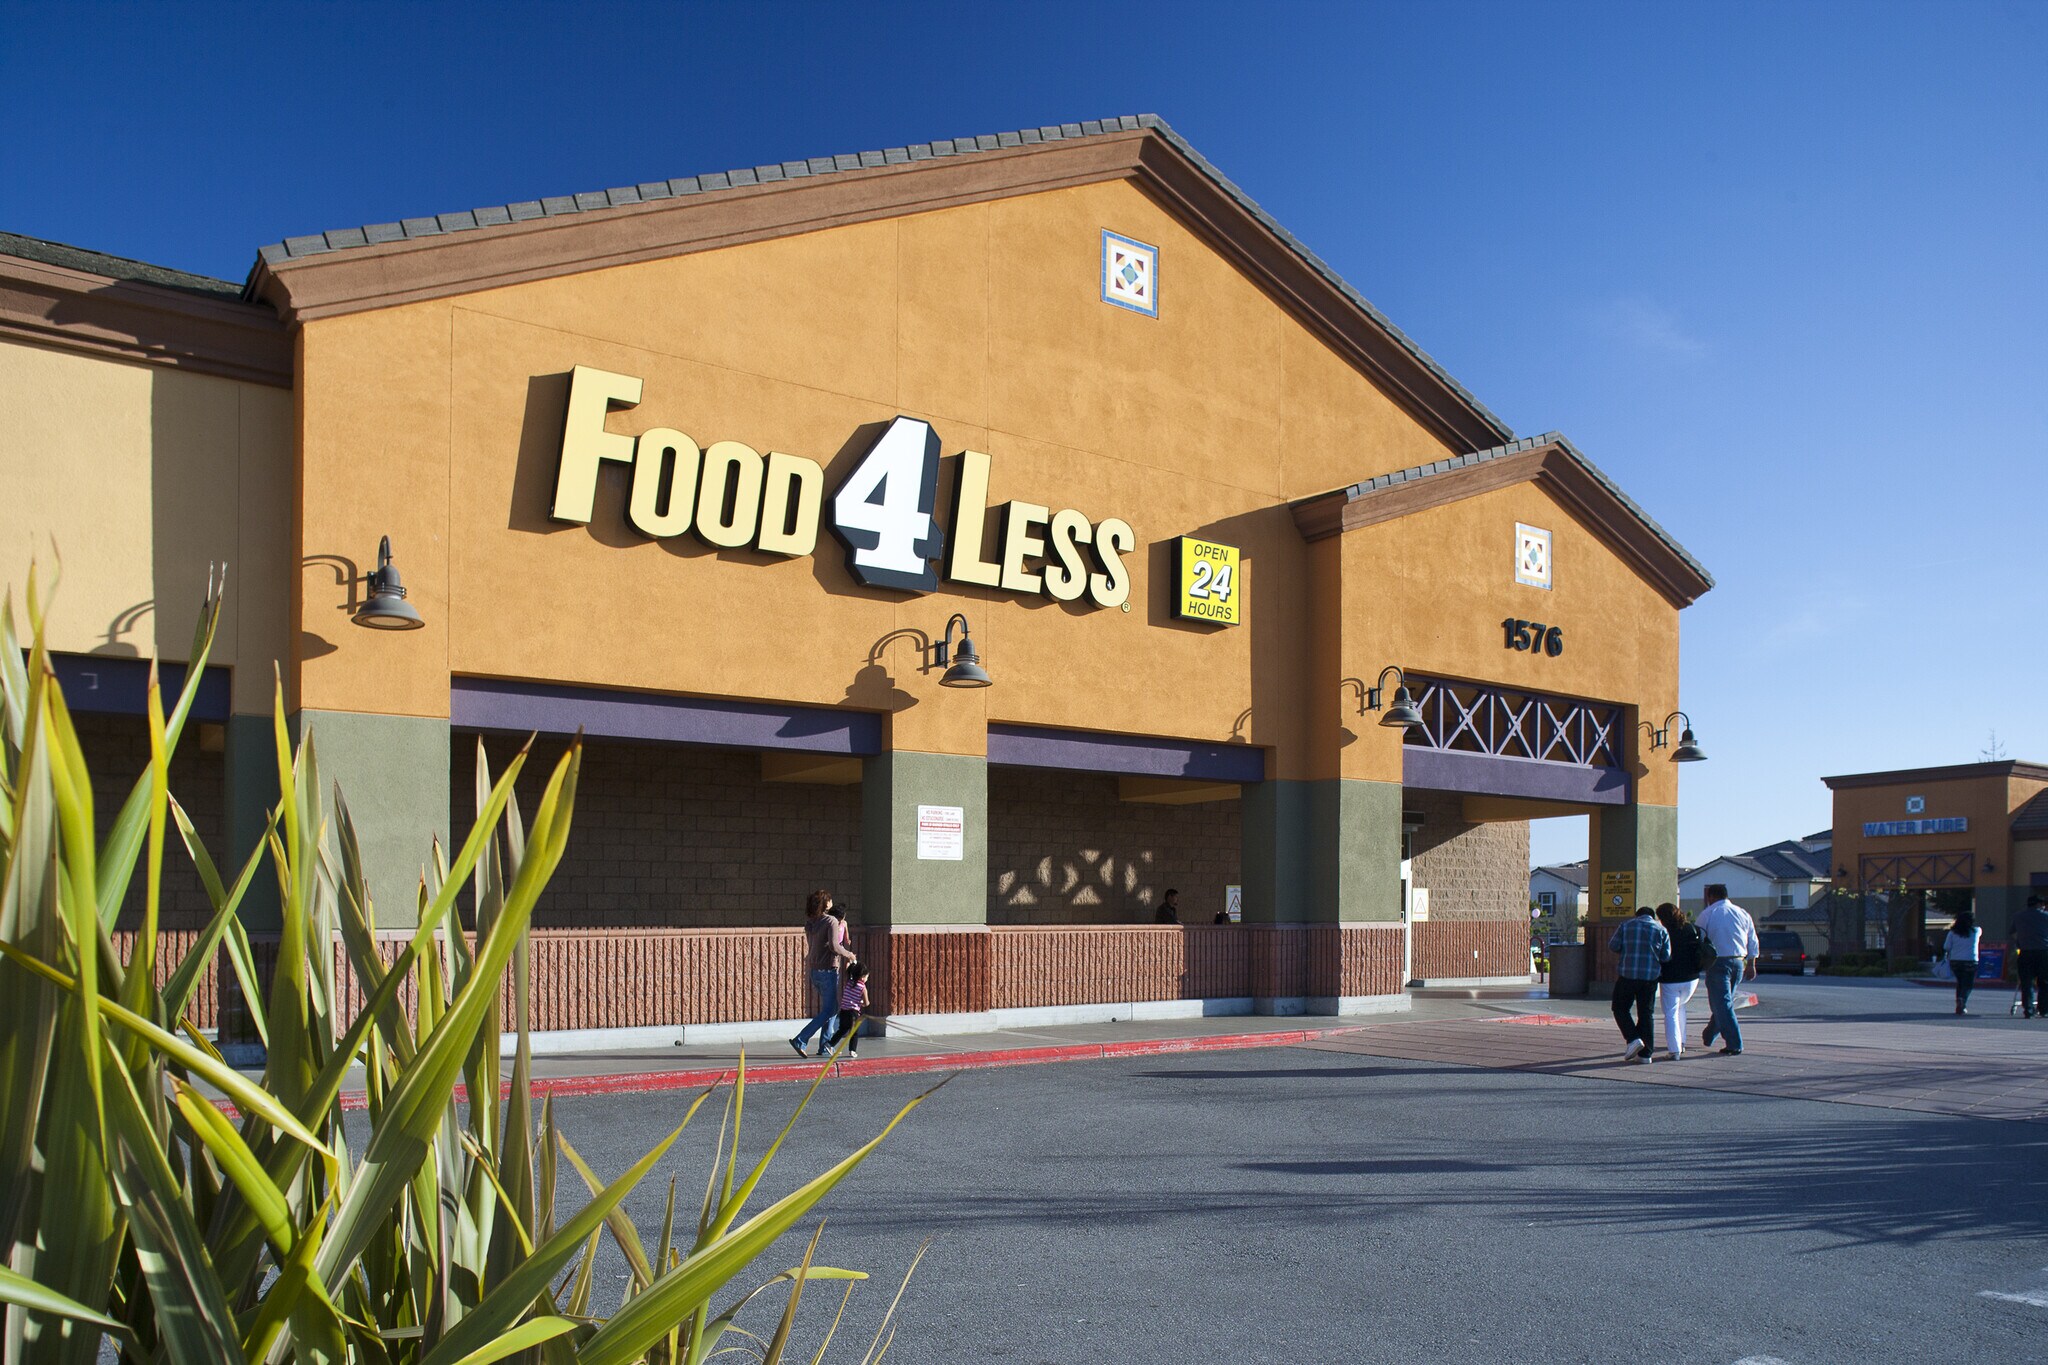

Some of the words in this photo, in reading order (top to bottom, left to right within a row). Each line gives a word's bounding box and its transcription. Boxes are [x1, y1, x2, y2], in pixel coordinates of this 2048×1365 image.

[551, 364, 825, 556] FOOD
[829, 415, 942, 588] 4
[1194, 544, 1229, 562] OPEN
[1189, 560, 1232, 603] 24
[1188, 601, 1233, 620] HOURS
[1501, 617, 1563, 657] 1576
[1864, 821, 1916, 837] WATER
[1921, 818, 1966, 833] PURE
